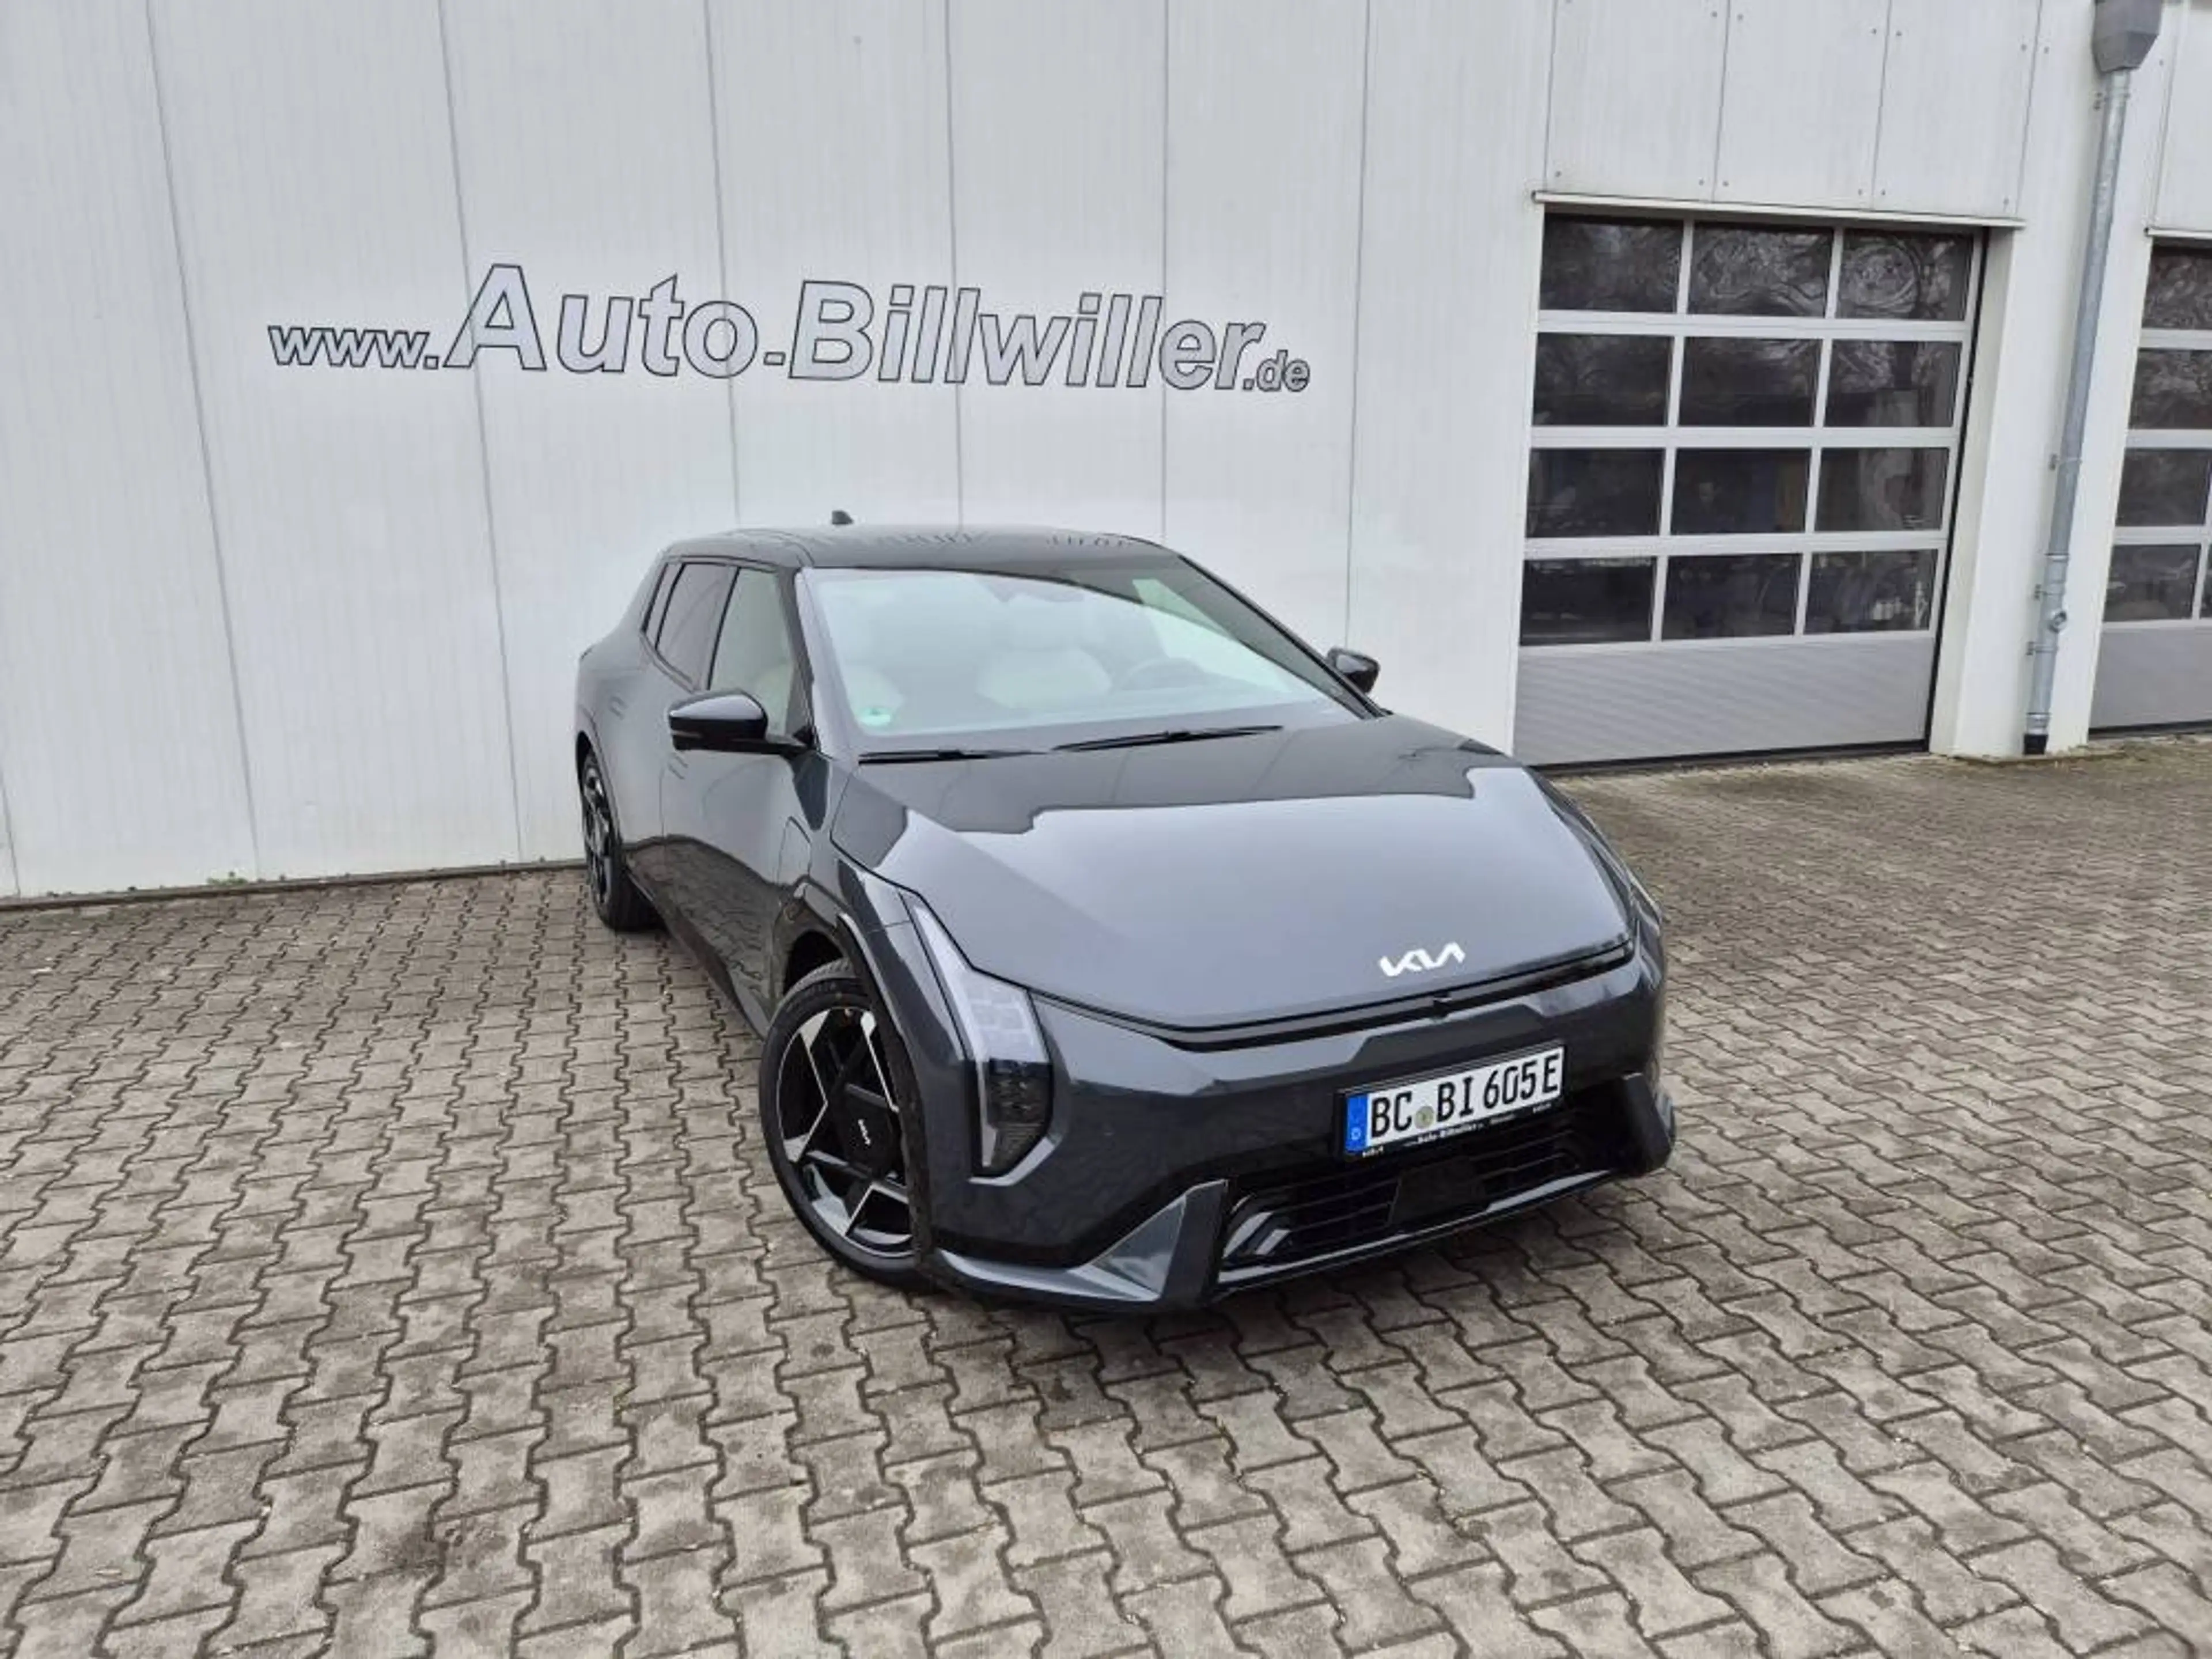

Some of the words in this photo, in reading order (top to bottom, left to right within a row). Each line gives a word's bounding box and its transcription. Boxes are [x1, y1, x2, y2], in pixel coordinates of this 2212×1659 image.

[267, 263, 1310, 392] www.Auto-Billwiller.de
[1372, 1090, 1412, 1138] BC
[1437, 1076, 1474, 1123] BI
[1483, 1054, 1560, 1109] 605E
